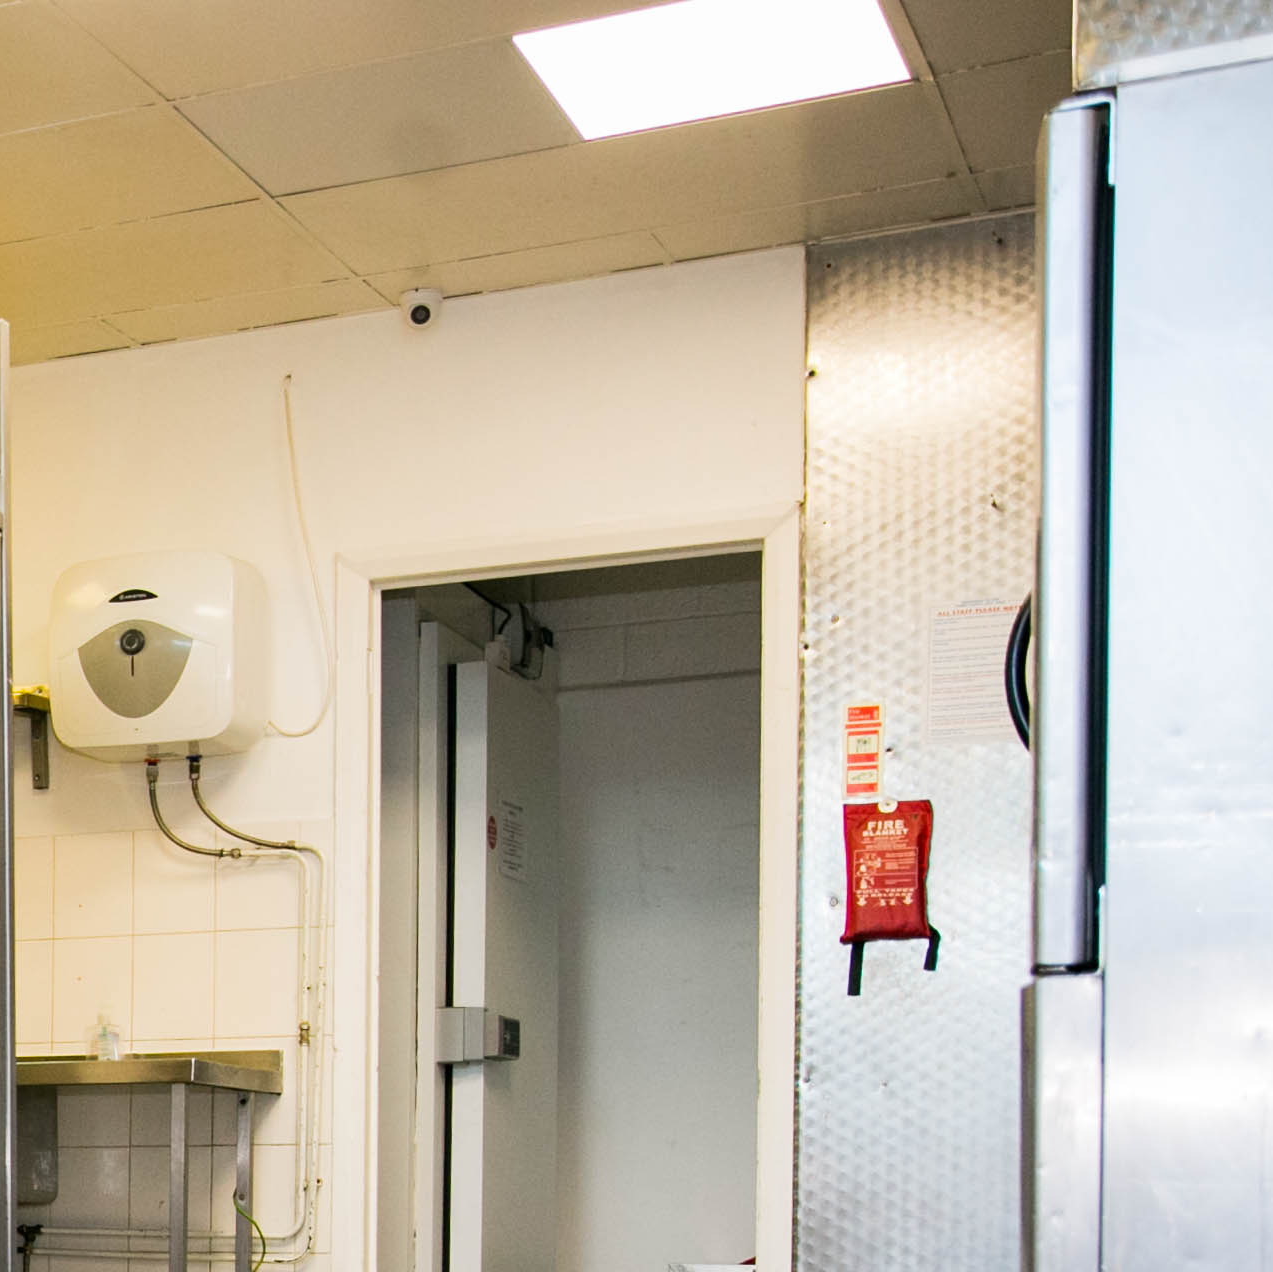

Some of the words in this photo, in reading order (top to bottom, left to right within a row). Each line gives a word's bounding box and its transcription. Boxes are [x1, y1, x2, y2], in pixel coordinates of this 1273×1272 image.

[974, 606, 999, 614] PLEASE
[867, 819, 904, 831] FIRE
[862, 828, 908, 836] BLANKET
